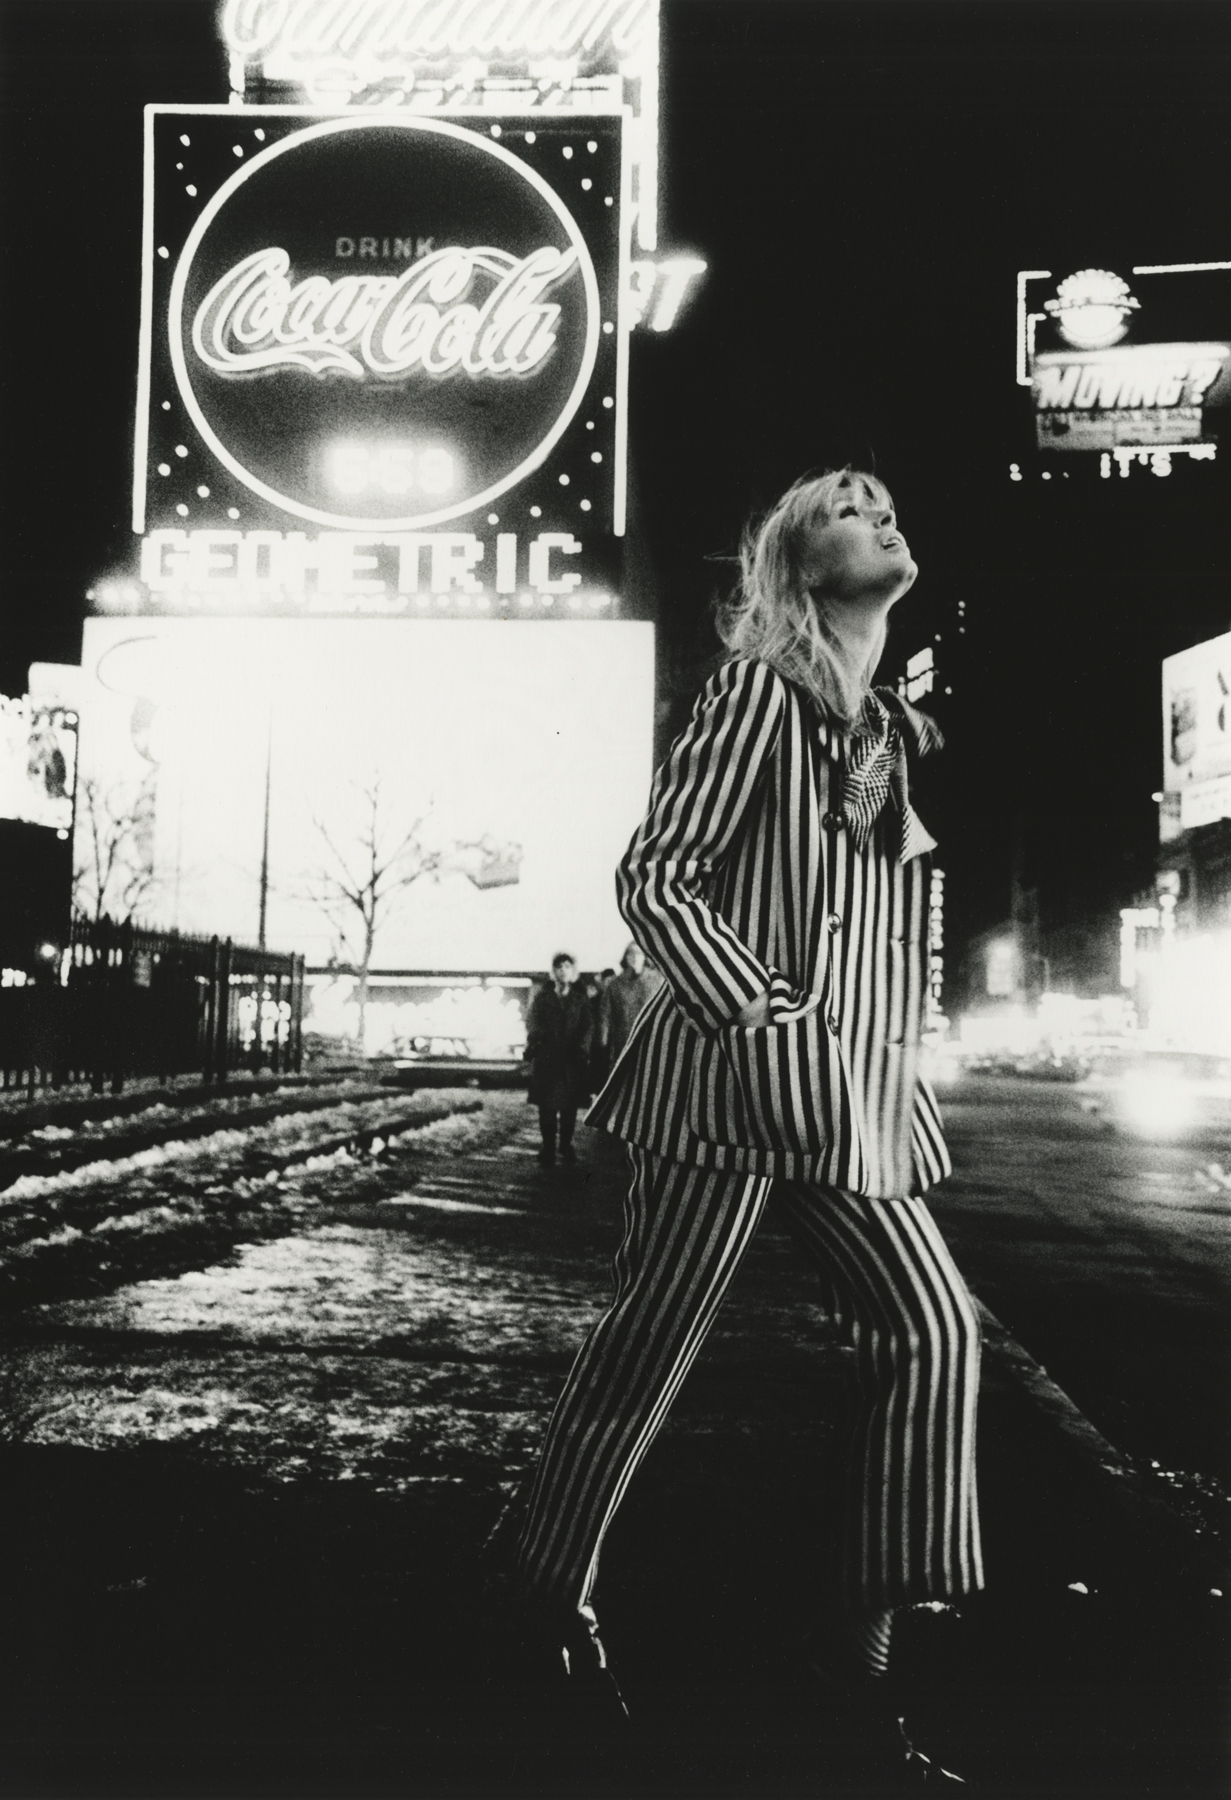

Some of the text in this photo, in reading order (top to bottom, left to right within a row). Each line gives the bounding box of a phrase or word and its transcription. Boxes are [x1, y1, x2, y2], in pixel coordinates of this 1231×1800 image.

[335, 236, 434, 258] DRINK
[1036, 361, 1222, 407] MOVING?
[141, 528, 582, 594] GEOMETRIC
